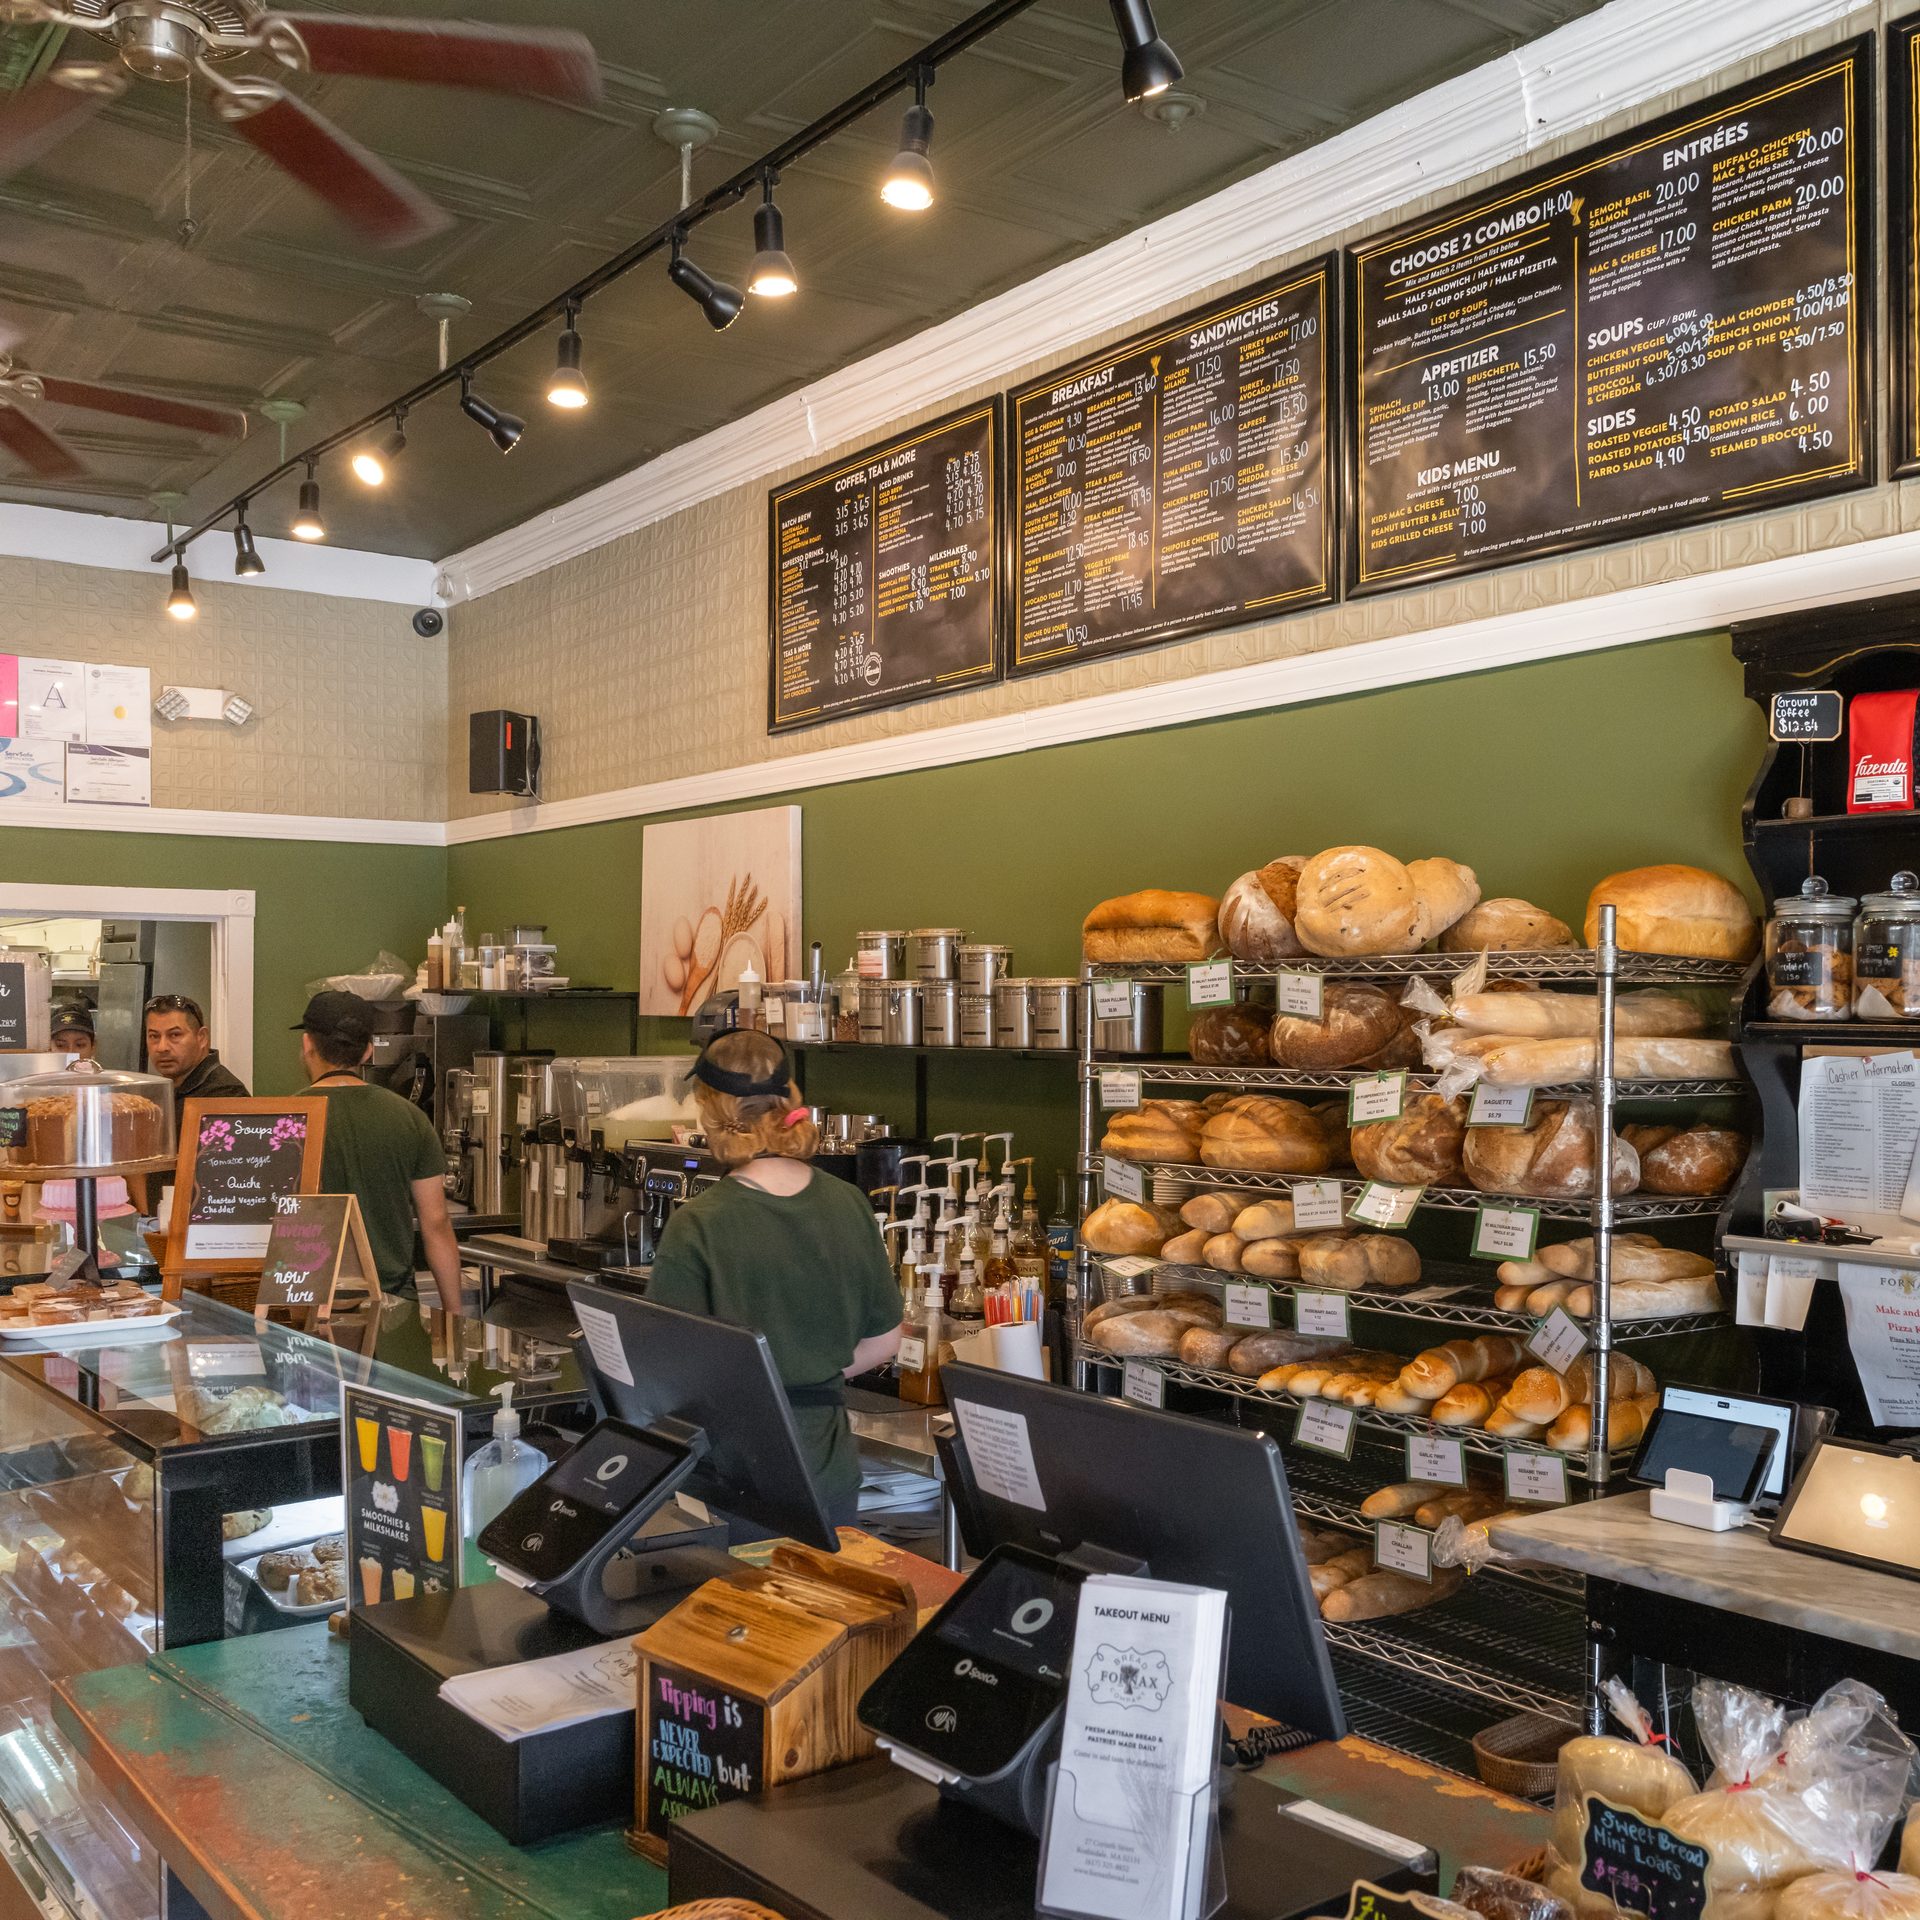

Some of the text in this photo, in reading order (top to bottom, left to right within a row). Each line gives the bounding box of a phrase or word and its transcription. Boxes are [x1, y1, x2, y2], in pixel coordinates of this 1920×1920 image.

[1663, 122, 1749, 171] ENTRÉES
[1712, 128, 1811, 173] BUFFALO CHICKEN
[1712, 127, 1843, 183] MAC & CHEESE 20.00
[1589, 172, 1700, 219] LEMON BASIL 20.00
[1712, 176, 1844, 232] CHICKEN PARM 20.00
[1390, 190, 1574, 277] CHOOSE 2 COMBO 14.00
[1589, 208, 1629, 229] SALMON
[1589, 222, 1697, 276] MAC & CHEESE 17.00
[1405, 290, 1425, 305] HALF
[1427, 273, 1471, 299] SANDWICH
[1478, 263, 1499, 278] HALF
[1500, 255, 1525, 273] WRAP
[1430, 299, 1488, 326] LIST OF SOUPS
[1707, 272, 1854, 331] CLAM CHOWDER 6.50/8.50
[1707, 291, 1850, 345] FRENCH ONION 7.00/9.00
[1189, 301, 1279, 350] SANDWICHES
[1587, 318, 1644, 349] SOUPS
[1647, 319, 1665, 331] CUP
[1672, 309, 1698, 324] BOWL
[1707, 321, 1845, 361] SOUP OF THE DAY 5.50/7.50
[1421, 345, 1499, 384] APPETIZER
[1466, 343, 1556, 384] BRUSCHETTA 15.50
[1587, 349, 1629, 367] CHICKEN
[1631, 335, 1666, 357] VEGGIE
[1051, 367, 1114, 405] BREAKFAST
[1428, 379, 1460, 402] 13.00
[1587, 354, 1706, 396] BROCCOLI 6.30/8.30
[1369, 398, 1401, 415] SPINACH
[1587, 382, 1642, 405] & CHEDDAR
[1708, 370, 1831, 420] POTATO SALAD 4.50
[1163, 404, 1235, 442] CHICKEN PARM 16.00
[1370, 400, 1426, 425] ARTICHOKE DIP
[1587, 408, 1636, 437] SIDES
[1587, 406, 1701, 451] ROASTED VEGGIE 4.50
[1709, 395, 1829, 434] BROWN RICE 6.00
[1588, 425, 1710, 465] ROASTED POTATOES 4.50
[1709, 418, 1783, 443] (contains cranberries)
[1710, 423, 1817, 458] STEAMED BROCCOLI
[1798, 430, 1833, 454] 4.50
[835, 449, 916, 493] COFFEE, TEA & MORE
[1417, 450, 1500, 487] KIDS MENU
[1589, 446, 1685, 480] FARRO SALAD 4.90
[1371, 501, 1487, 537] PEANUT BUTTER & JELLY 7.00
[928, 544, 968, 563] MILKSHAKES
[878, 563, 910, 580] SMOOTHIES
[1776, 708, 1810, 718] coffee
[1777, 695, 1817, 707] Ground
[1779, 718, 1818, 734] $12.84
[1855, 755, 1908, 776] Fazenda
[1828, 1060, 1914, 1084] Cashier Information
[234, 1119, 273, 1140] Soups
[227, 1177, 261, 1189] Quiche
[273, 1270, 310, 1285] now
[286, 1284, 314, 1303] here
[1876, 1305, 1900, 1316] Make
[1888, 1322, 1912, 1333] Pizza
[361, 1508, 410, 1531] SMOOTHIES &
[363, 1521, 409, 1543] MILKSHAKES
[1094, 1606, 1170, 1624] TAKEOUT MENU
[969, 1667, 998, 1686] SpotOn
[1113, 1654, 1148, 1671] BREAD
[658, 1677, 717, 1730] Tipping
[722, 1695, 743, 1729] is
[659, 1718, 700, 1754] NEVER
[1085, 1725, 1105, 1734] FRESH
[1107, 1728, 1133, 1739] ARTISAN
[1135, 1732, 1157, 1742] BREAD
[1088, 1736, 1157, 1752] PASTRIES MADE DAILY
[652, 1738, 752, 1792] EXPECTED but
[1593, 1824, 1626, 1855] Mini
[1601, 1810, 1704, 1868] Sweet Bread
